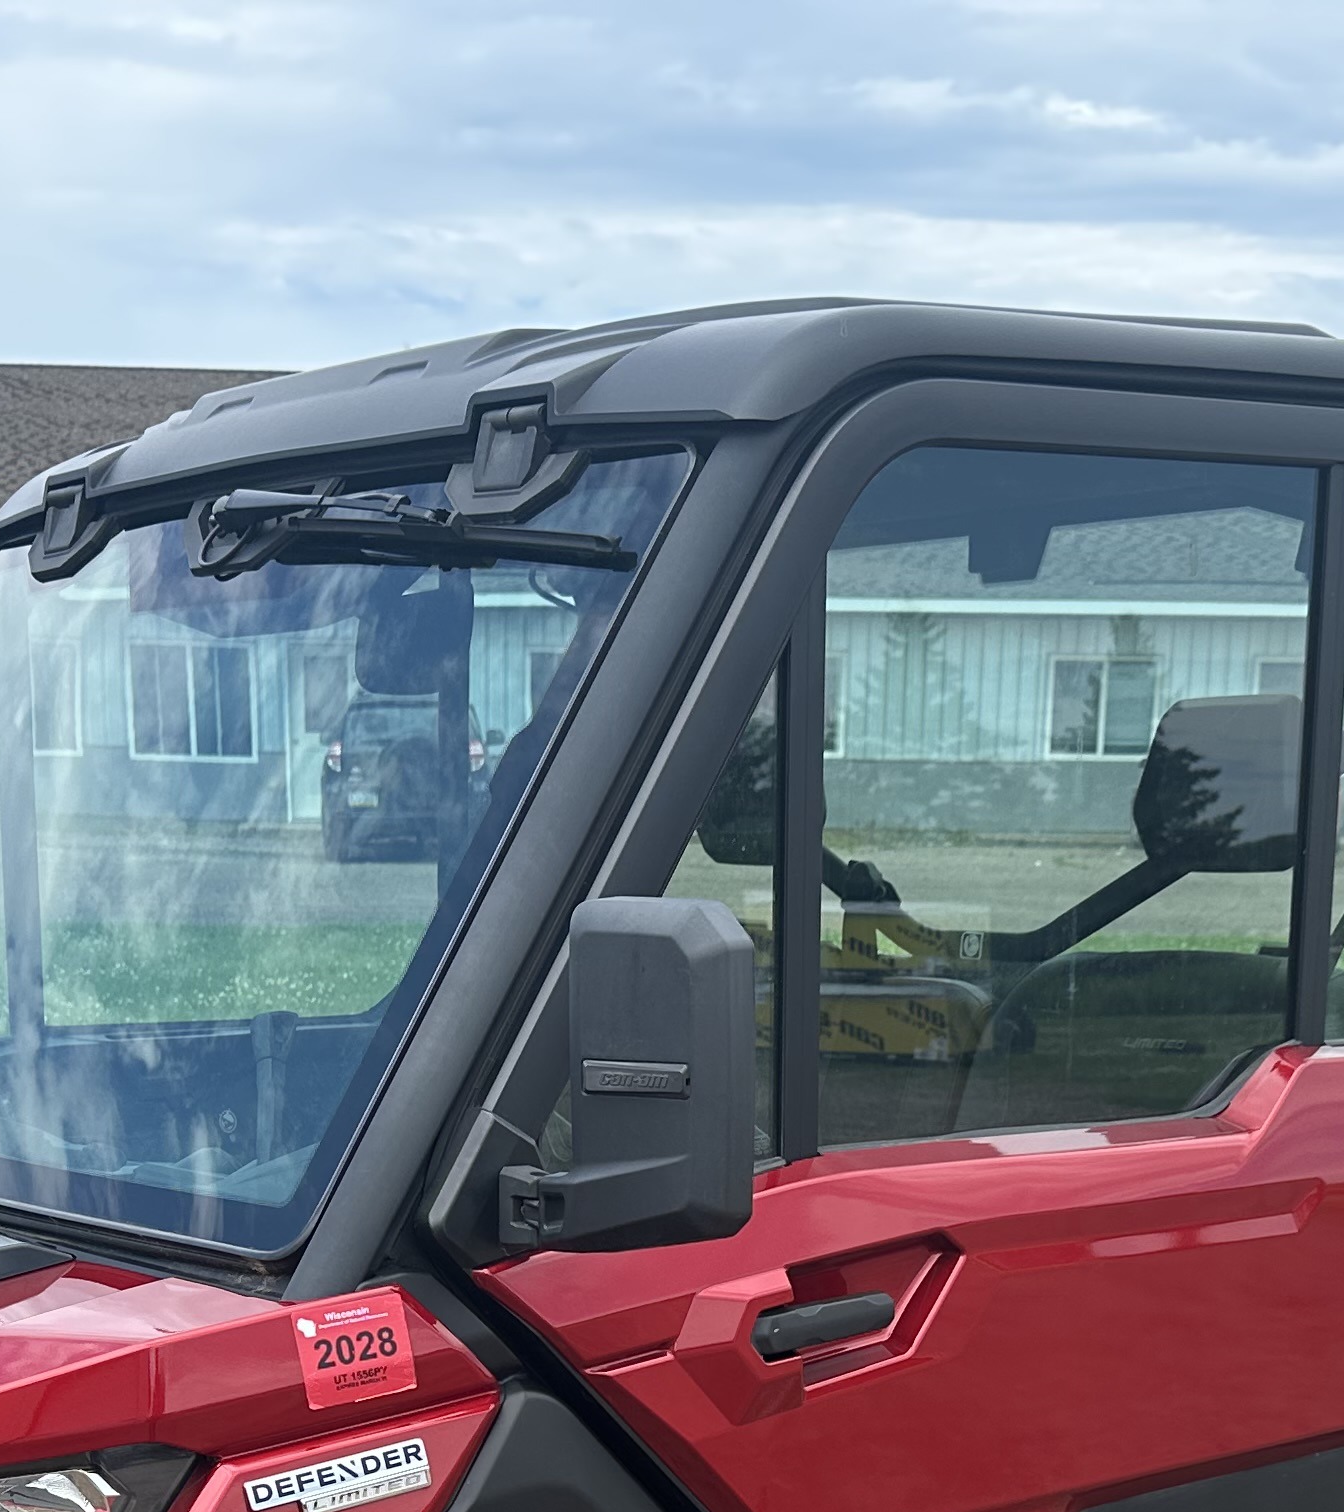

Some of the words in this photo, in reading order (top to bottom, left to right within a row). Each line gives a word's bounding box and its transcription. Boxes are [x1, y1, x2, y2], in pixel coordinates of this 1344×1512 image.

[599, 1073, 669, 1089] can-am
[324, 1306, 370, 1321] Wisconsin
[314, 1326, 397, 1370] 2028
[251, 1443, 423, 1505] DEFENDER
[312, 1473, 421, 1510] LIMITED
